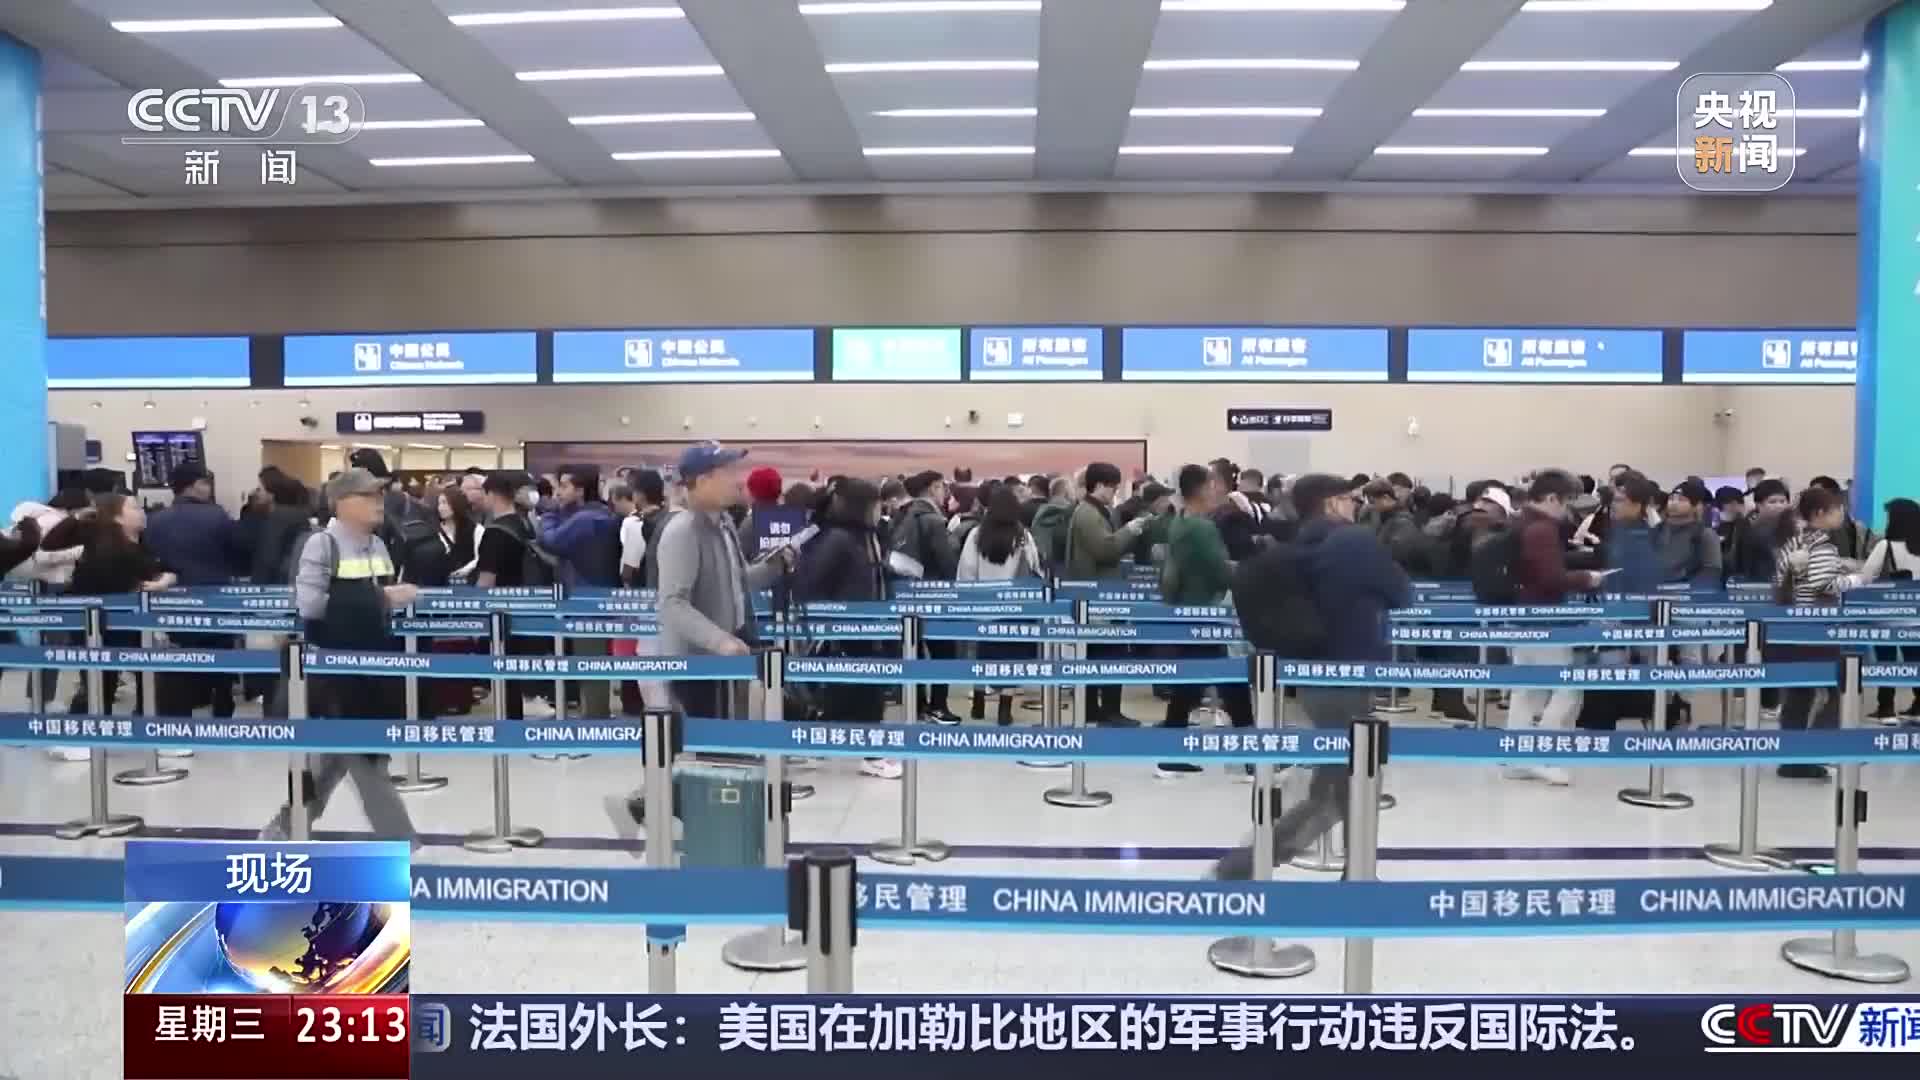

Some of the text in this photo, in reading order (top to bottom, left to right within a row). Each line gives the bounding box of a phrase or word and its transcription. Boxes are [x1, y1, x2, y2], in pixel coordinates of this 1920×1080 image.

[119, 652, 149, 662] CHINA
[325, 655, 359, 666] CHINA
[360, 656, 430, 668] IMMIGRATION
[493, 658, 688, 672] 中国移民管理 CHINA IMMIGRATION
[788, 662, 904, 674] CHINA IMMIGRATION
[972, 663, 1177, 676] 中国移民管理 CHINA IMMIGRATION
[1284, 663, 1490, 679] 中国移民管理 CHINA IMMIGRATION
[1559, 667, 1766, 682] 中国移民管理 CHINA IMMIGRATION
[28, 719, 295, 739] 中国移民管理 CHINA IMMIGRATION
[386, 724, 495, 742] 中国移民管理
[525, 727, 573, 741] CHINA
[792, 727, 1083, 749] 中国移民管理 CHINA IMMIGRATION
[1183, 734, 1299, 752] 中国移民管理
[1499, 735, 1780, 752] 中国移民管理 CHINA IMMIGRATION
[410, 877, 608, 902] A IMMIGRATION
[993, 888, 1078, 912] CHINA
[1085, 890, 1265, 915] IMMIGRATION
[1430, 885, 1904, 917] 中国移民管理 CHINA IMMIGRATION
